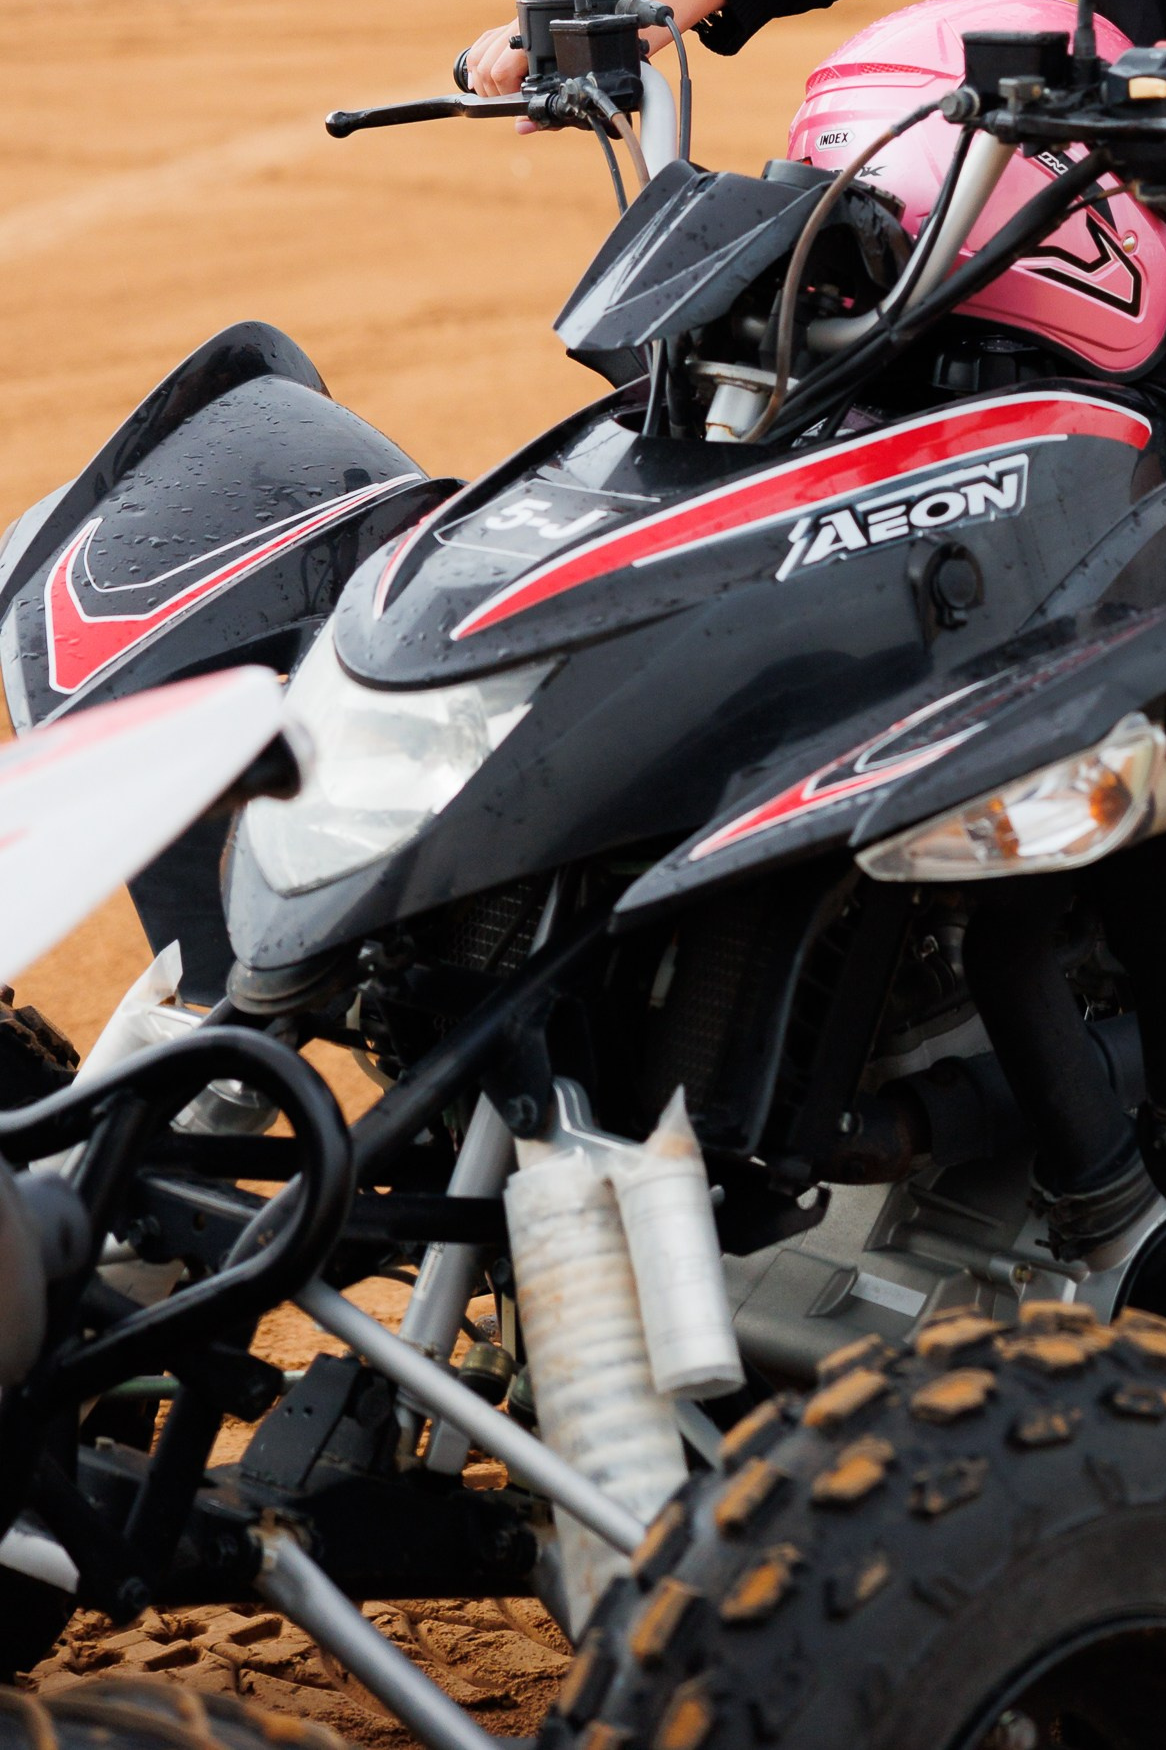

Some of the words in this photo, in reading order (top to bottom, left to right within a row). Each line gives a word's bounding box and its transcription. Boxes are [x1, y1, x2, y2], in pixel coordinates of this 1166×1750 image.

[819, 132, 849, 146] INDEX
[485, 499, 608, 539] 5-J
[800, 470, 1020, 566] AEON
